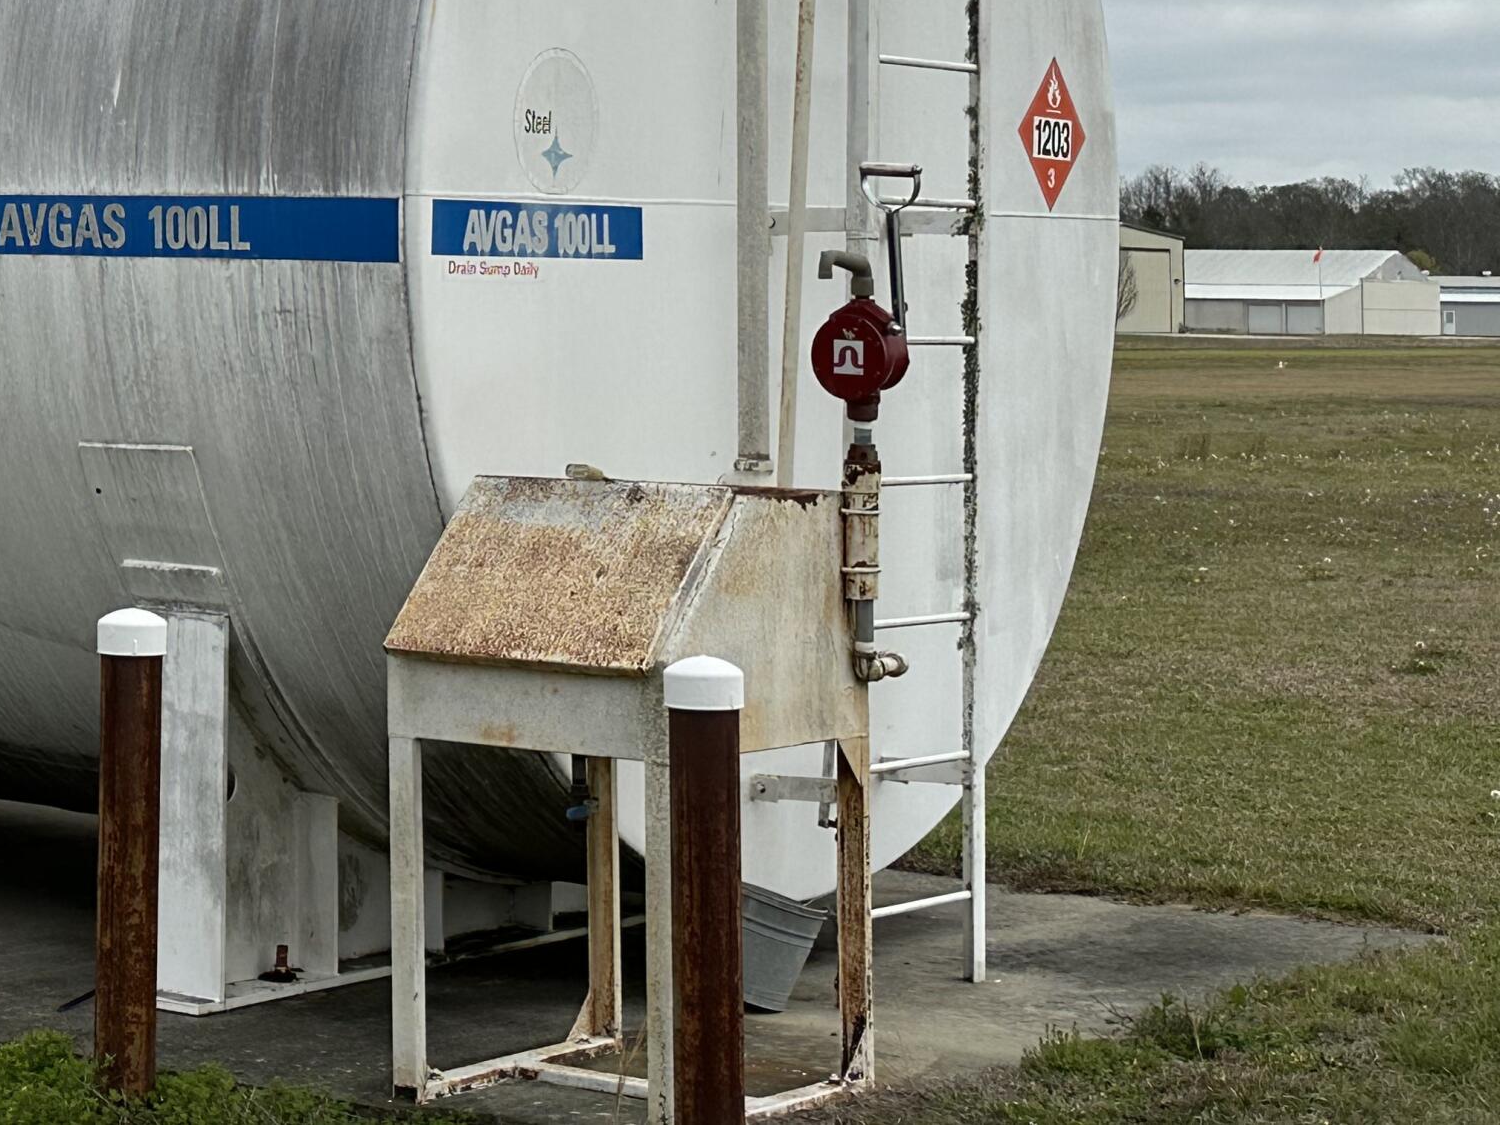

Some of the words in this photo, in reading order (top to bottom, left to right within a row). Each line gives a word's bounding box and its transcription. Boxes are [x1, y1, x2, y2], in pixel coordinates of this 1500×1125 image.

[524, 108, 551, 135] Steel
[1035, 119, 1070, 159] 1203
[1047, 167, 1055, 189] 3
[148, 204, 251, 251] 100LL
[463, 209, 549, 255] AVGAS
[554, 212, 615, 256] 100LL
[448, 260, 476, 275] Drain
[479, 261, 511, 277] Sump
[514, 261, 539, 279] Daily
